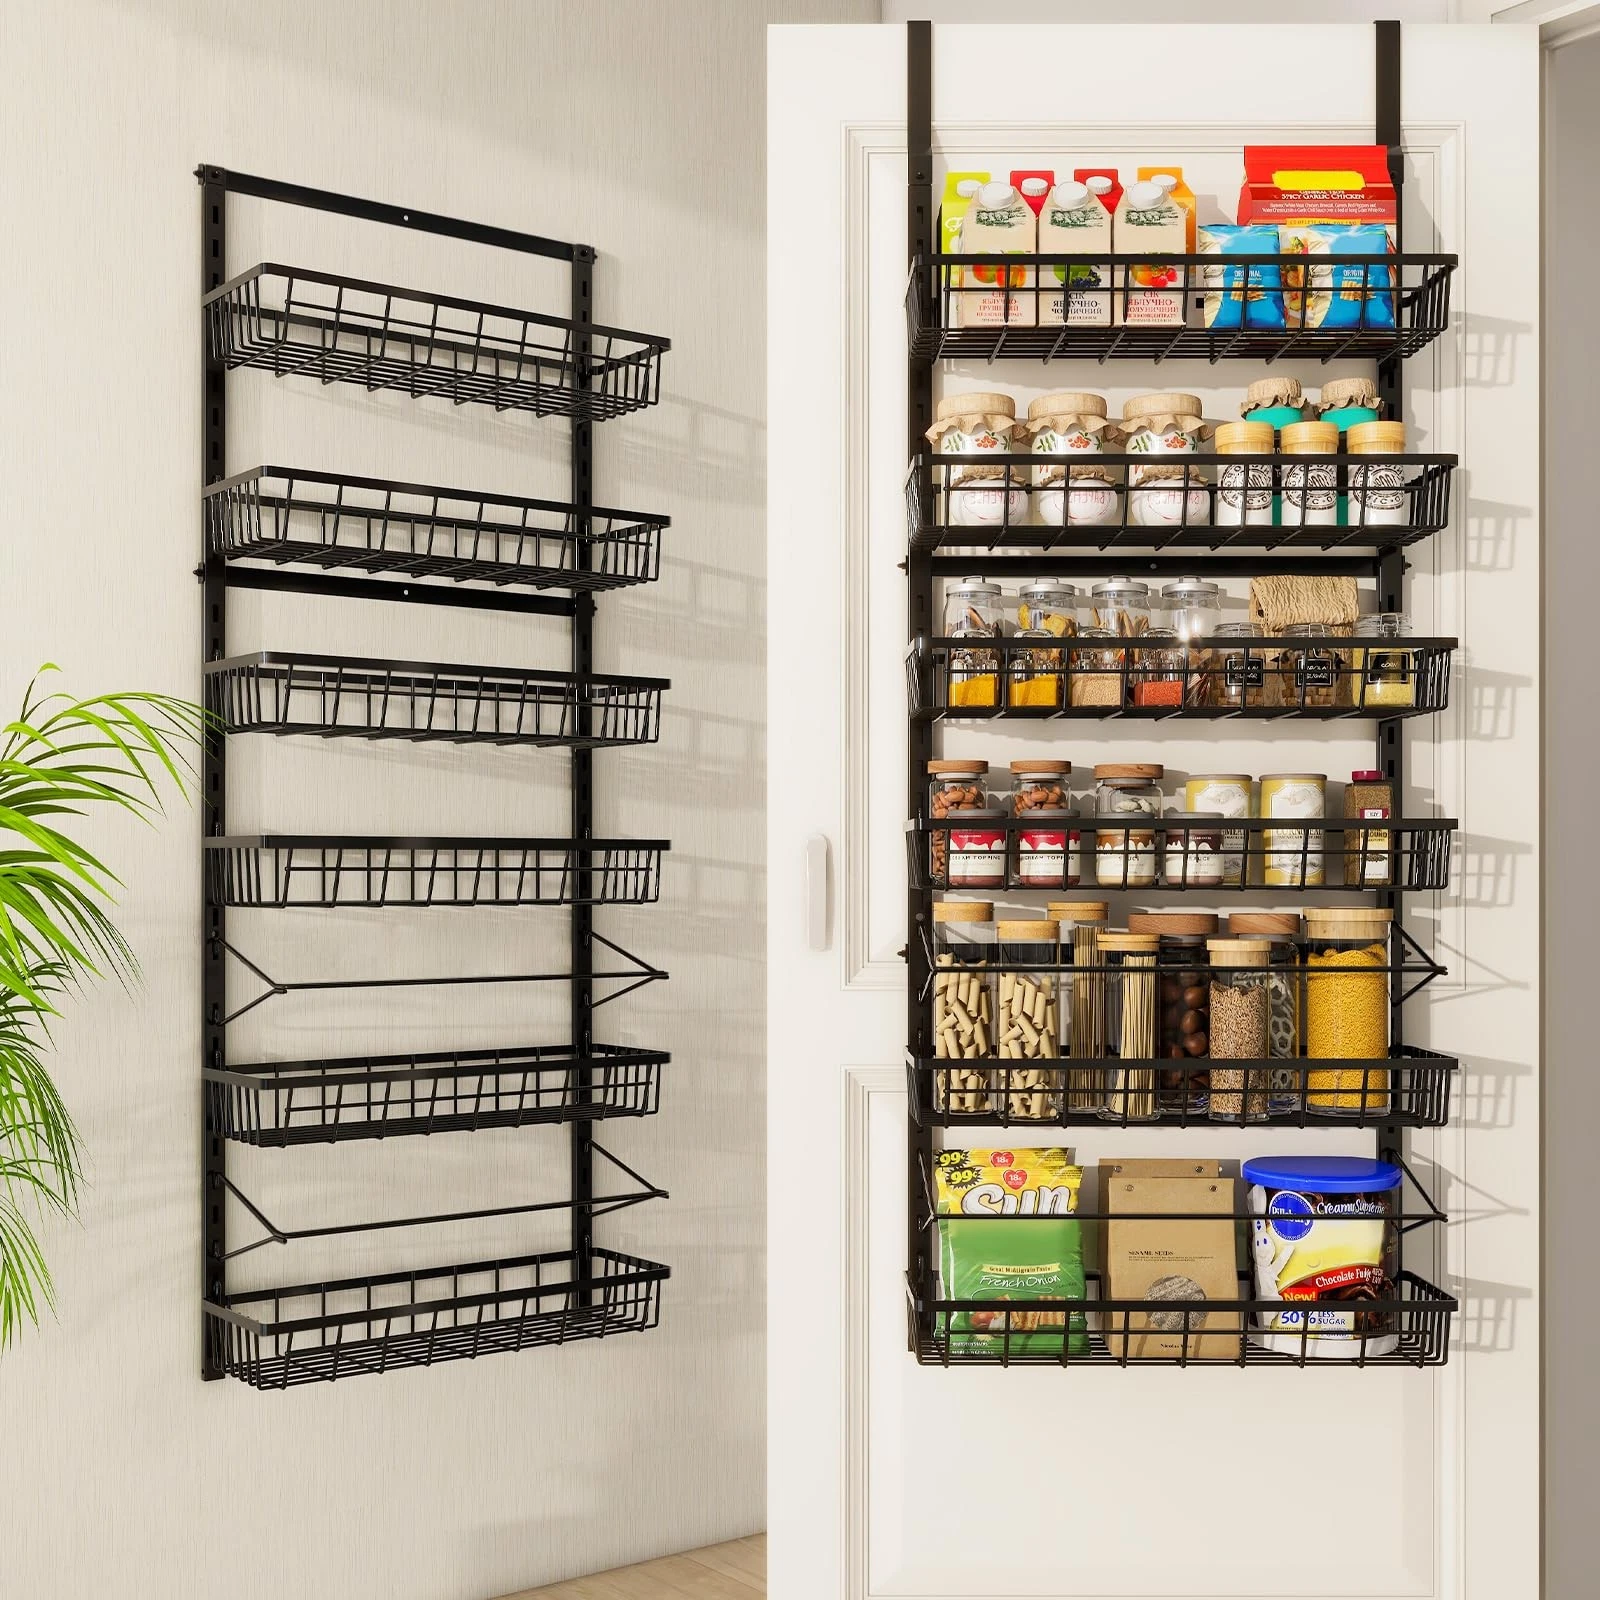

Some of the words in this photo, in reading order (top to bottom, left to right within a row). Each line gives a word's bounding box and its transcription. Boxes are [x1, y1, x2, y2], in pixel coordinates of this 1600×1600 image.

[950, 1169, 978, 1185] 99¢
[962, 1184, 1075, 1214] Sun
[1317, 1201, 1355, 1215] Creamy
[1355, 1198, 1385, 1215] Supreme
[980, 1275, 1025, 1288] French
[1026, 1274, 1061, 1288] Onion
[1315, 1271, 1355, 1288] Chocolate
[1355, 1268, 1372, 1282] Fudge
[1283, 1291, 1317, 1301] New!
[1317, 1318, 1346, 1326] SUGAR
